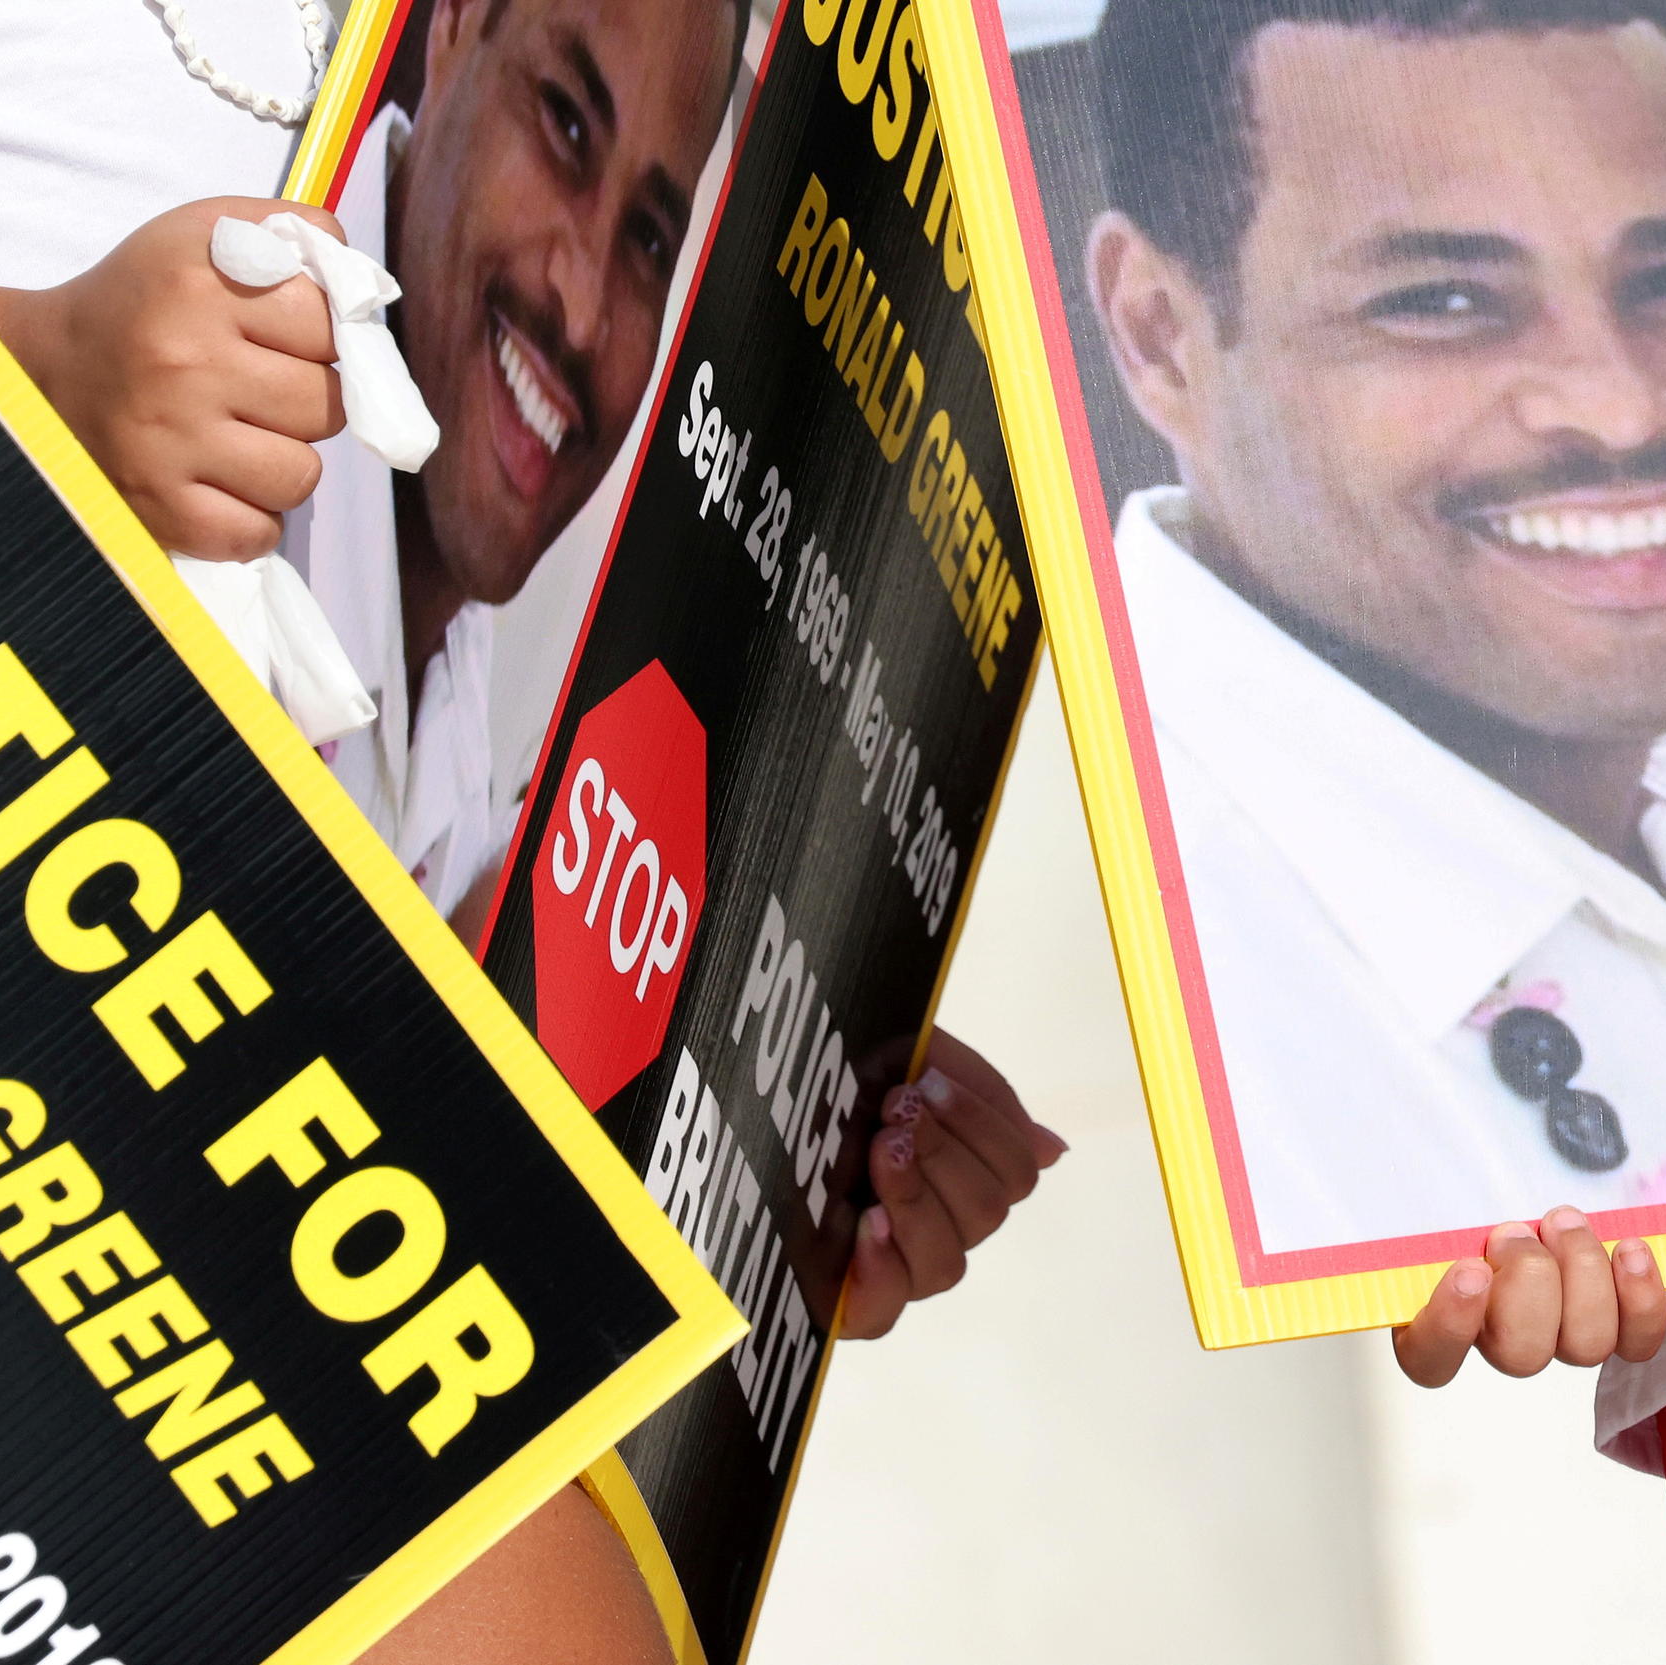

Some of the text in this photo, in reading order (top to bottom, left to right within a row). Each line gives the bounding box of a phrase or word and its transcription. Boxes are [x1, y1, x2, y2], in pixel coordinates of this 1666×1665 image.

[776, 172, 1023, 693] RONALD GREENE
[678, 360, 752, 531] Sept.
[744, 465, 793, 612] 28,
[786, 532, 850, 685] 1969
[844, 639, 895, 807] May
[883, 727, 920, 866] 10,
[904, 785, 958, 936] 2019
[551, 757, 689, 1003] STOP
[733, 893, 858, 1230] POLICE
[202, 1055, 536, 1459] FOR
[643, 1045, 818, 1476] BRUTALITY
